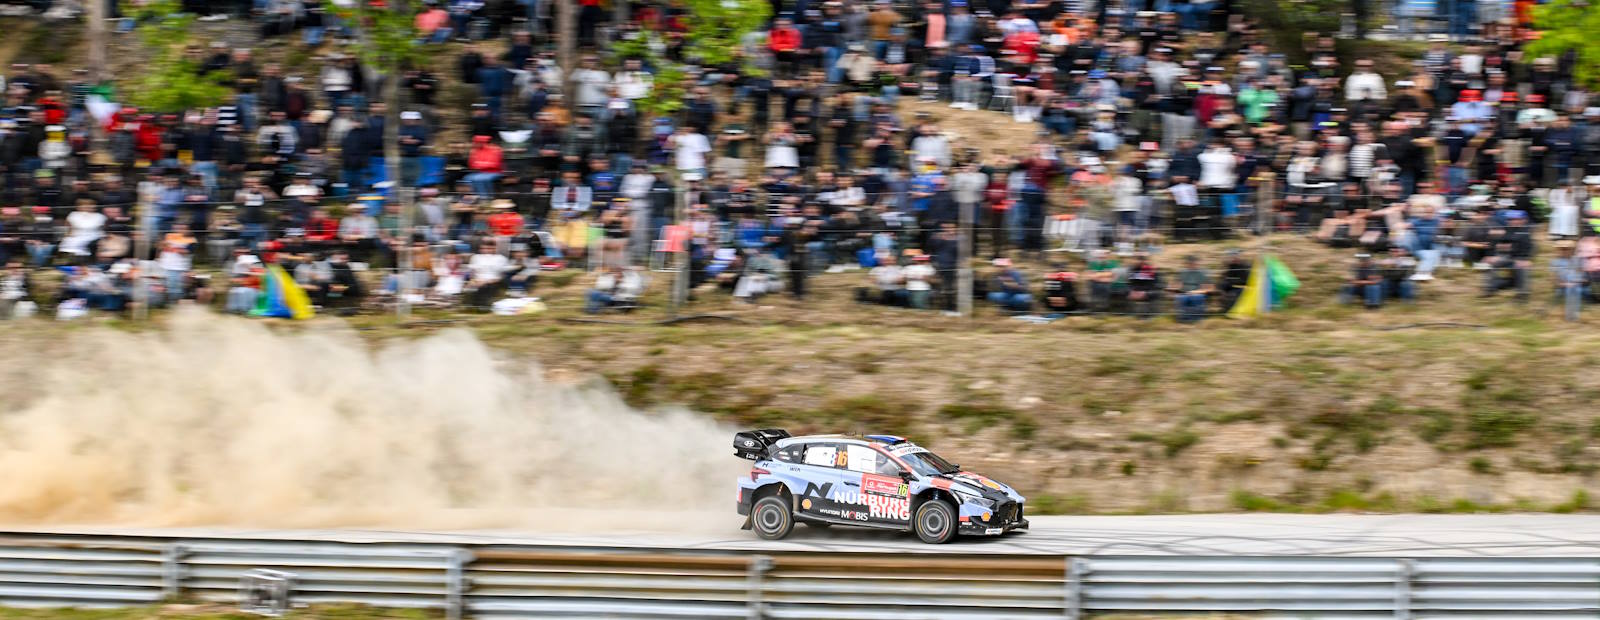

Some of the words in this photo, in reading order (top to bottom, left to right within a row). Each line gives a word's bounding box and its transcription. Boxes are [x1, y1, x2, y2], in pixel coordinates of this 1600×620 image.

[837, 450, 848, 466] 16
[899, 484, 908, 496] 16
[841, 510, 868, 521] MOBIS
[870, 505, 910, 520] RING
